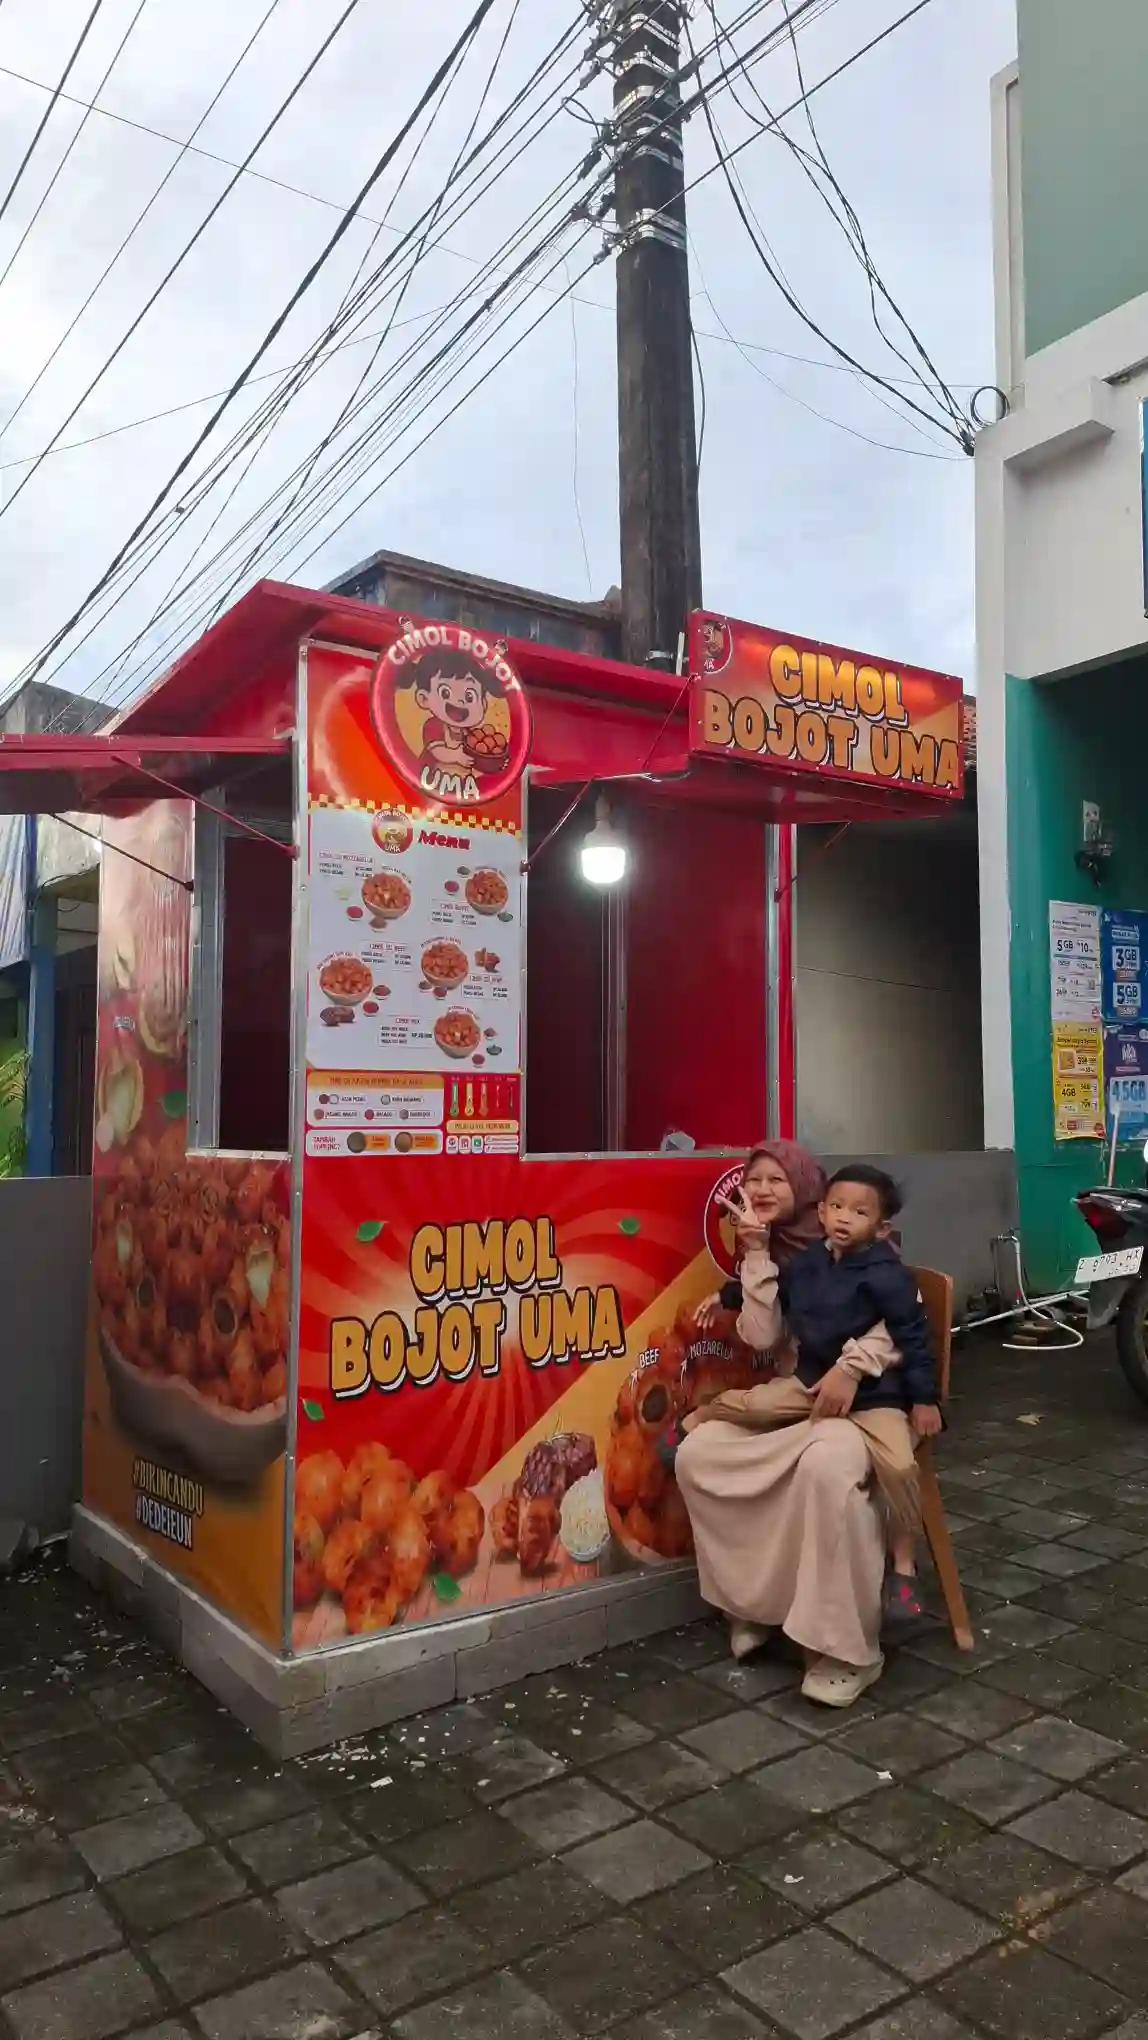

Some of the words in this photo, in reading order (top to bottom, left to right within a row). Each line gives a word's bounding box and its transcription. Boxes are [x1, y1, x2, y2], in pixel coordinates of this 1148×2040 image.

[388, 626, 452, 665] CIMOL
[769, 644, 908, 728] CIMOL
[703, 689, 859, 771] BOJOT
[869, 725, 959, 789] UMA
[420, 766, 480, 800] UMA
[411, 1216, 561, 1304] CIMOL
[330, 1299, 506, 1401] BOJOT
[518, 1285, 627, 1367] UMA
[639, 1347, 660, 1369] BEEF
